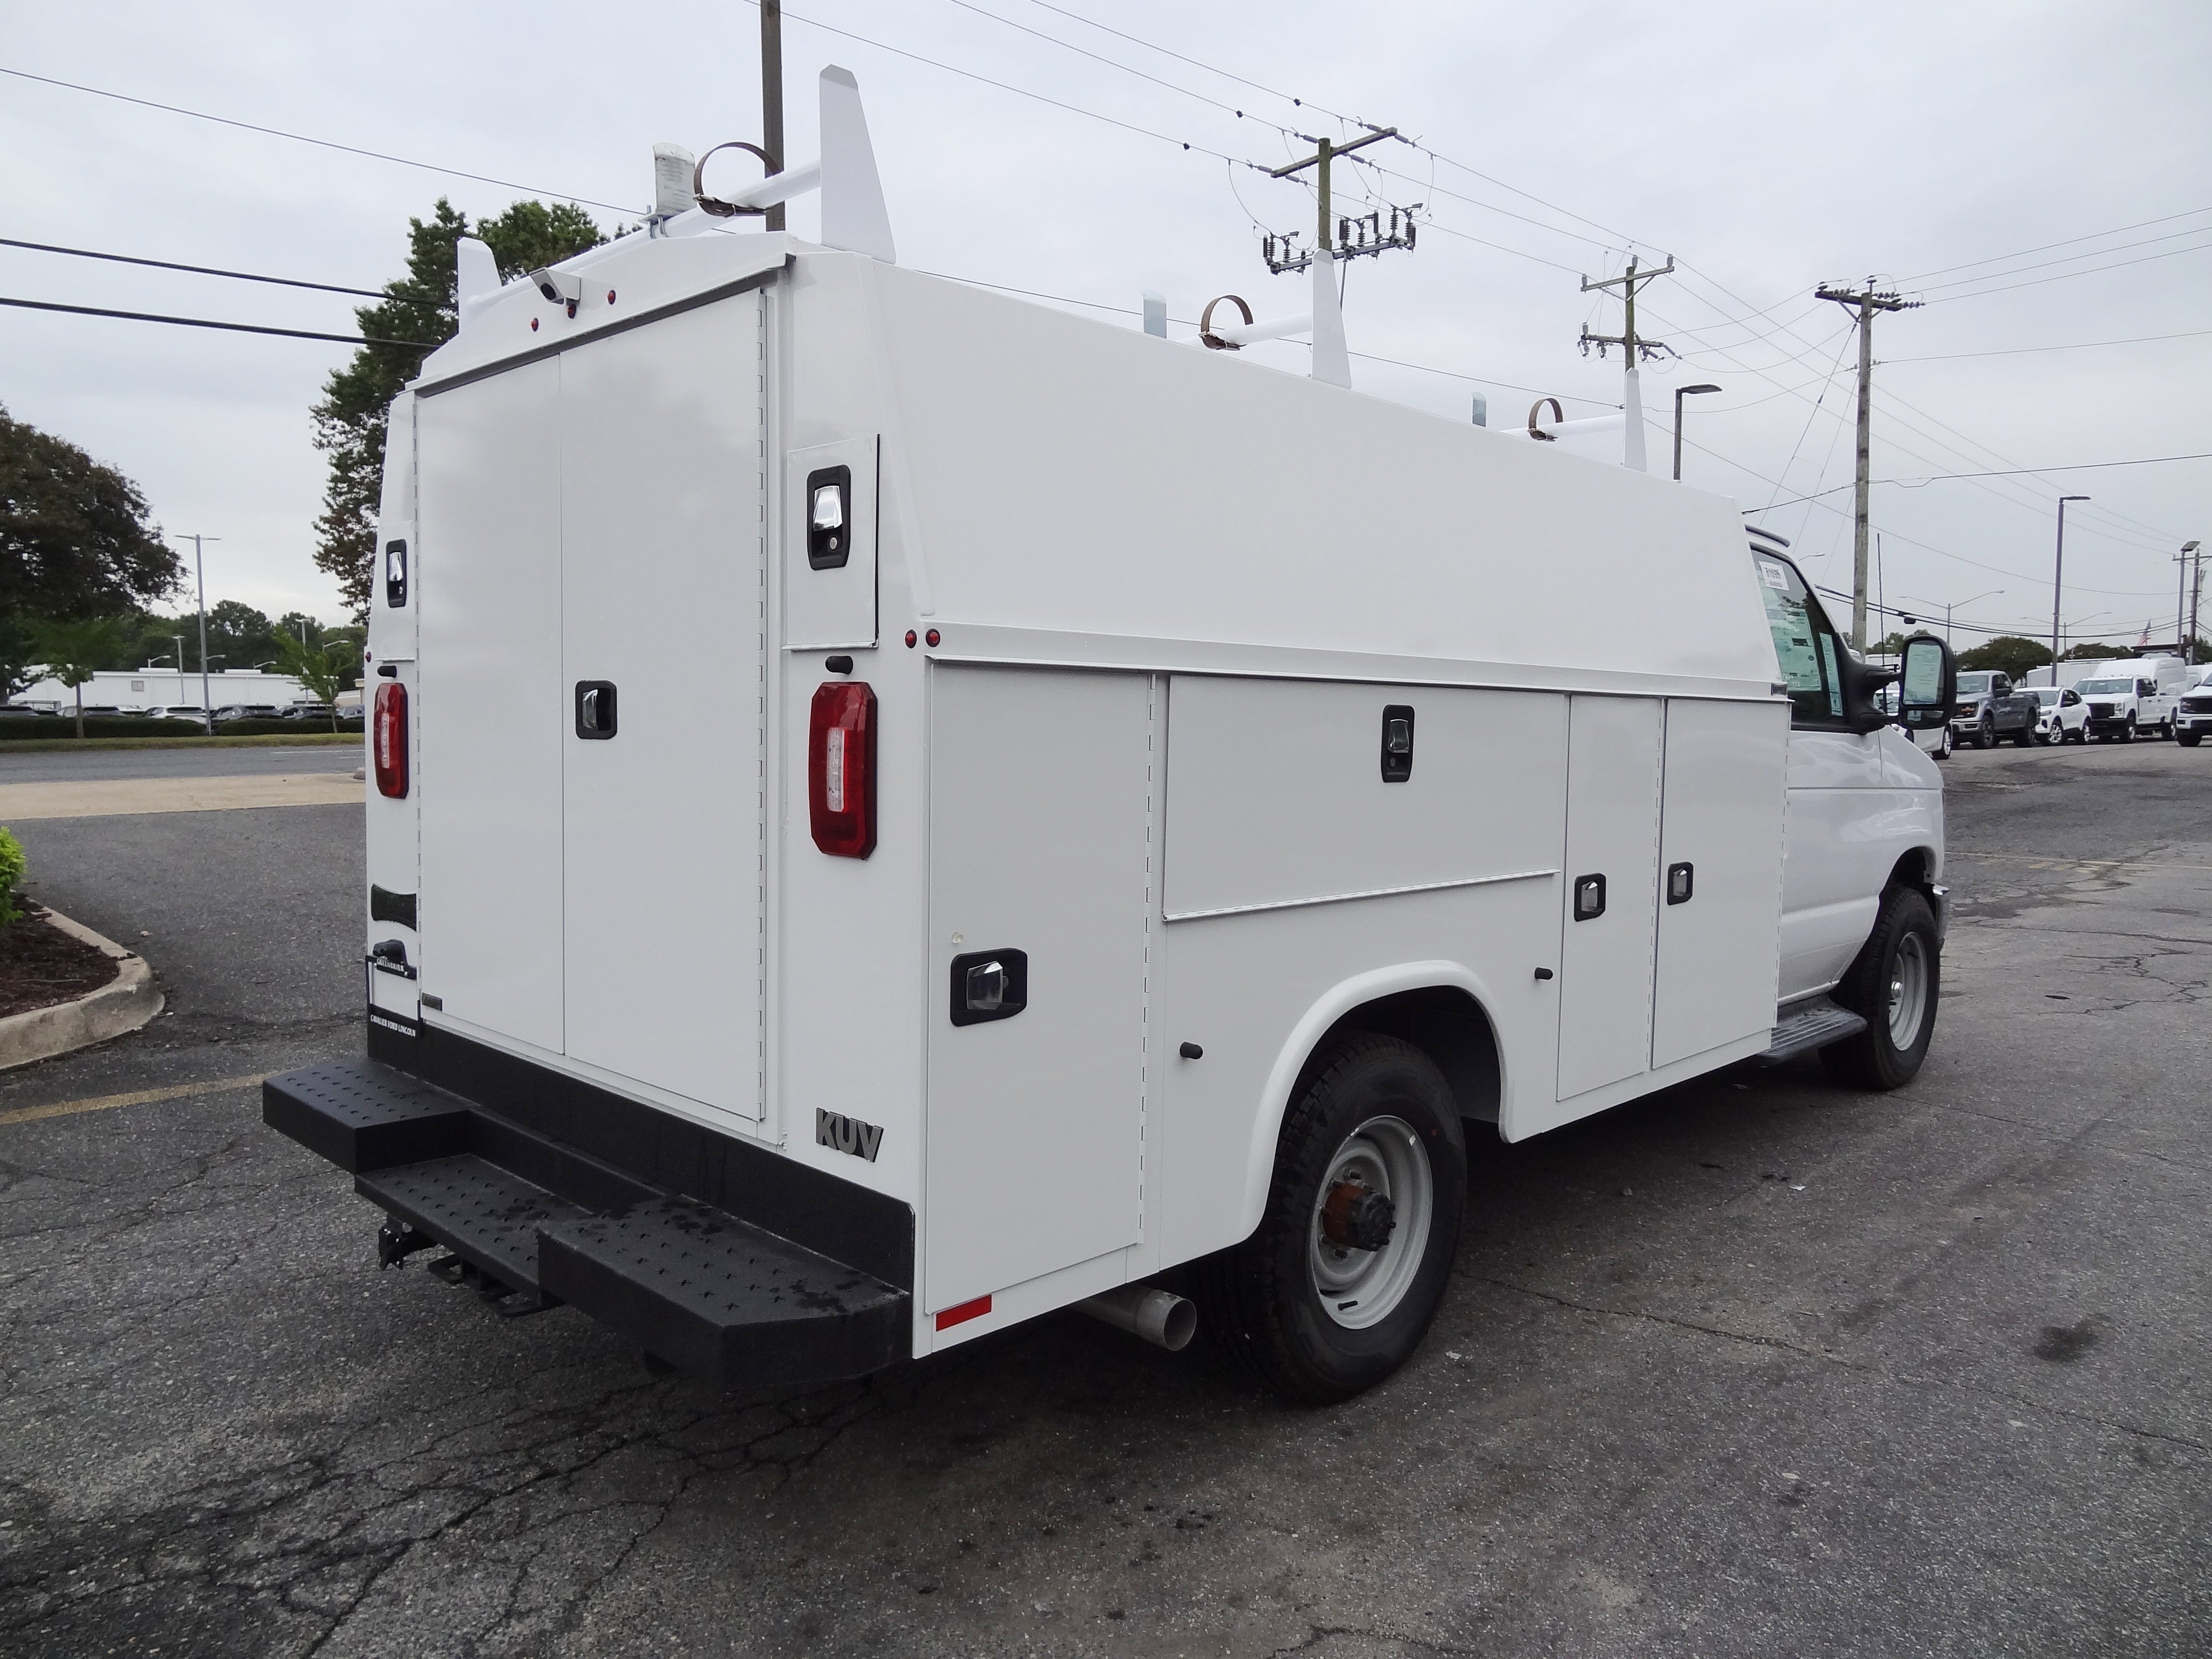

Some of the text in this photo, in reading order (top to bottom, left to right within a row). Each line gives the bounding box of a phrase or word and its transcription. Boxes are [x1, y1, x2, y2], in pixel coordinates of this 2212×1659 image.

[371, 1014, 416, 1037] CAVALIER FORD LINCOLN
[816, 1107, 884, 1163] KUV
